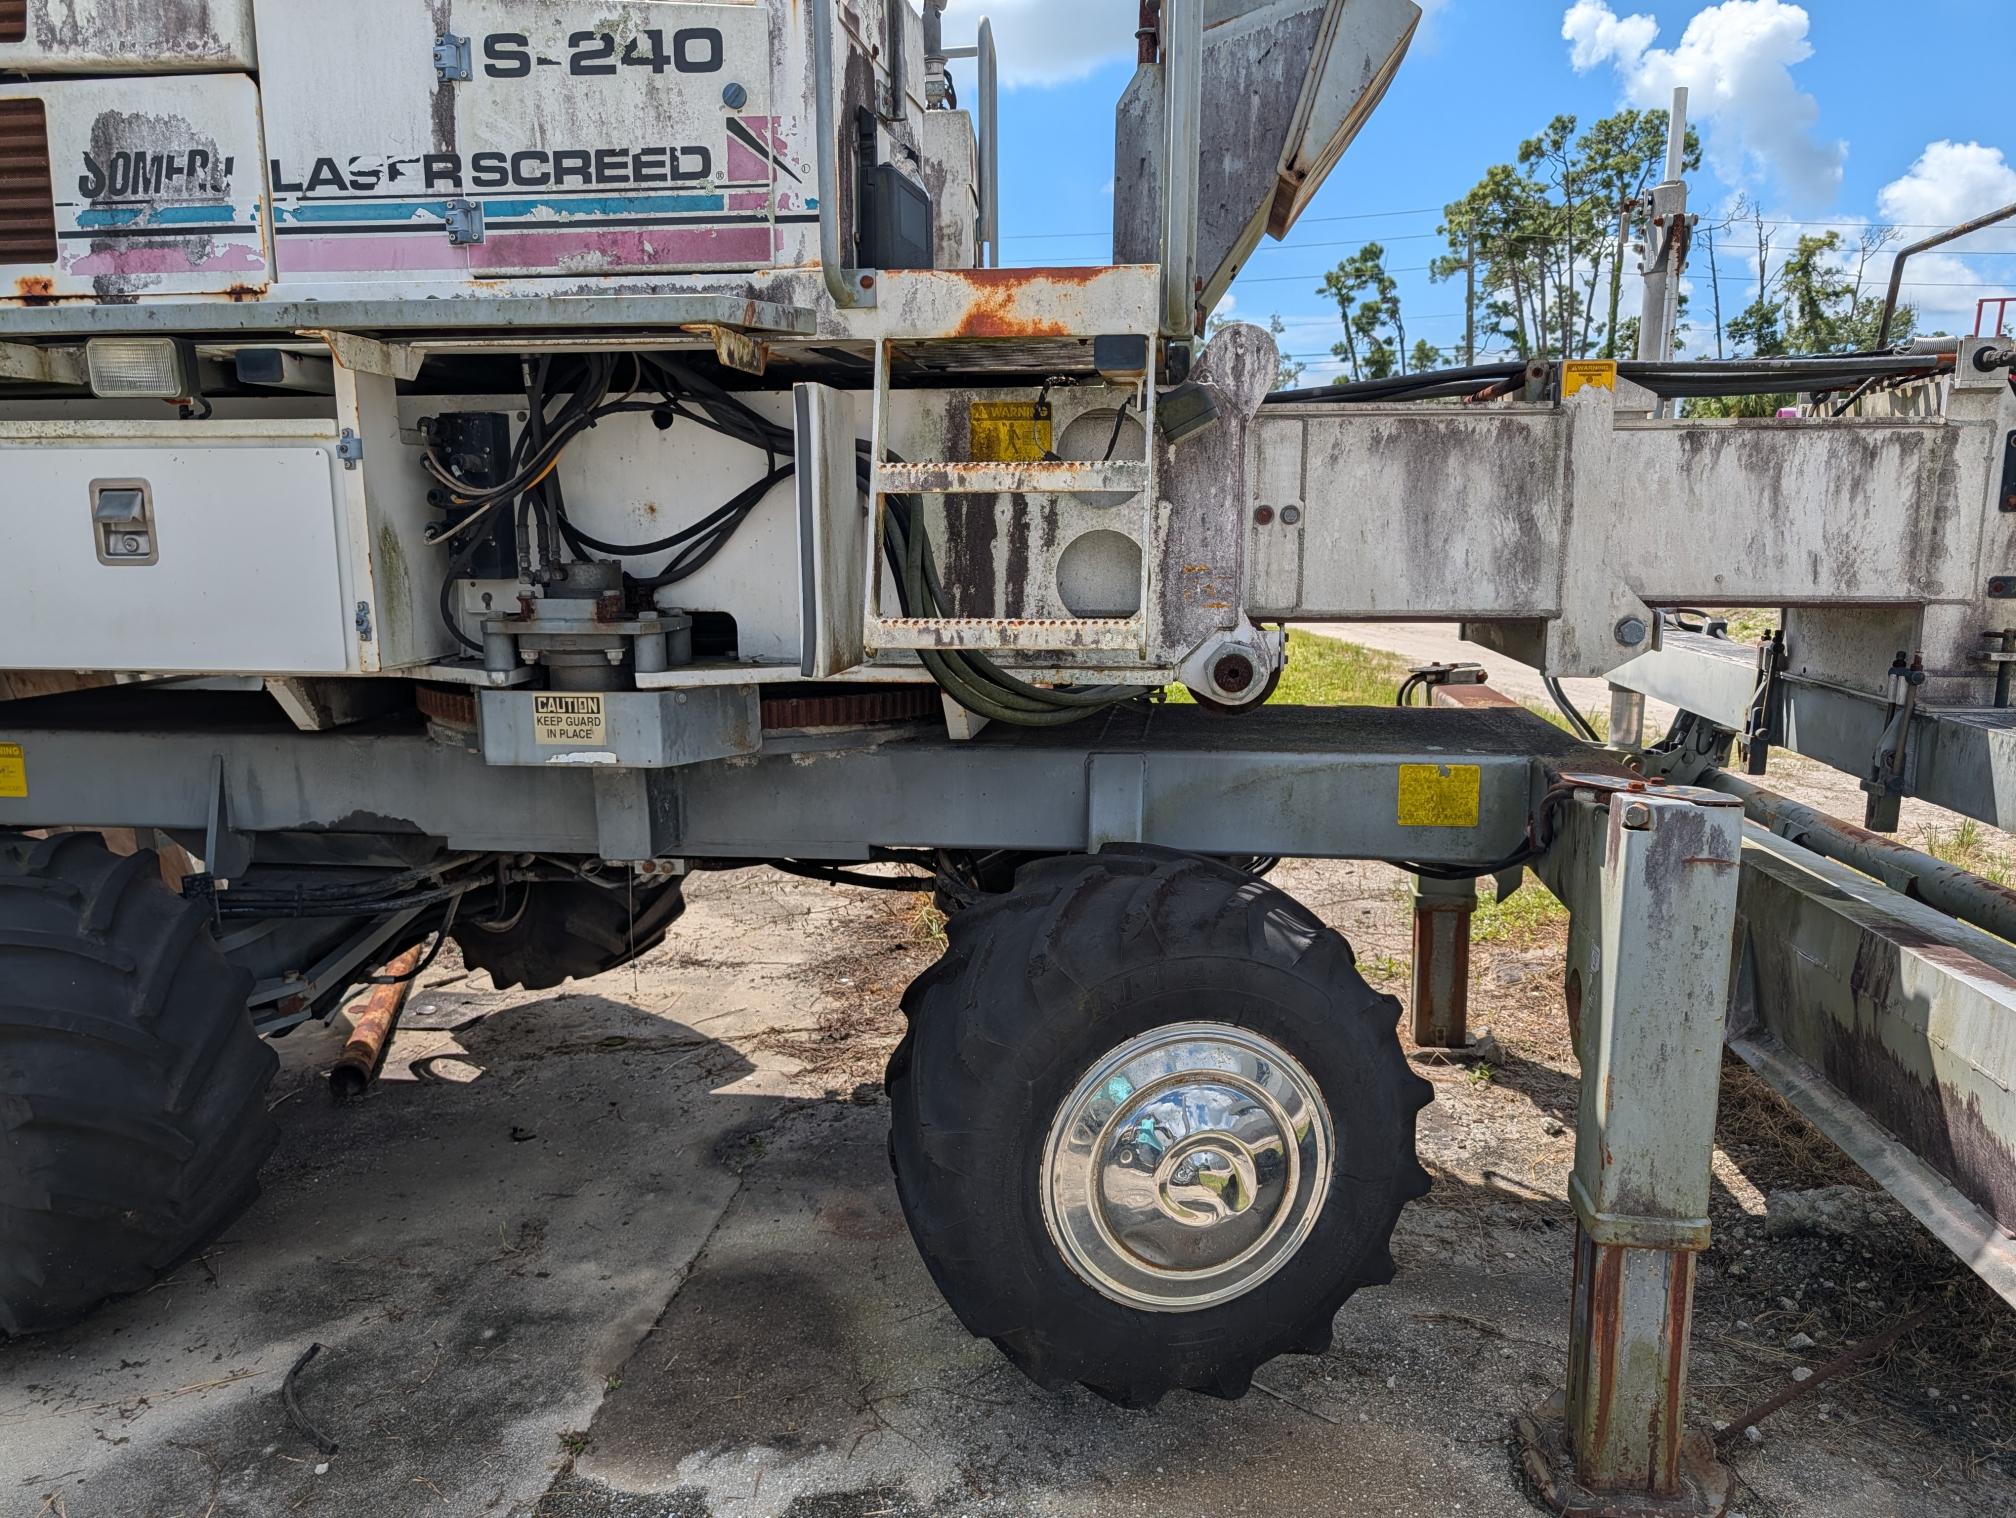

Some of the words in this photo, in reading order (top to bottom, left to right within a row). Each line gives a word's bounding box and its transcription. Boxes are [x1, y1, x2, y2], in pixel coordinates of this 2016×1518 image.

[484, 27, 723, 78] S-240
[471, 146, 711, 187] SCREED
[537, 697, 598, 713] CAUTION
[536, 716, 563, 726] KEEP
[565, 716, 601, 727] GUARD
[546, 729, 557, 738] IN
[560, 729, 592, 739] PLACE
